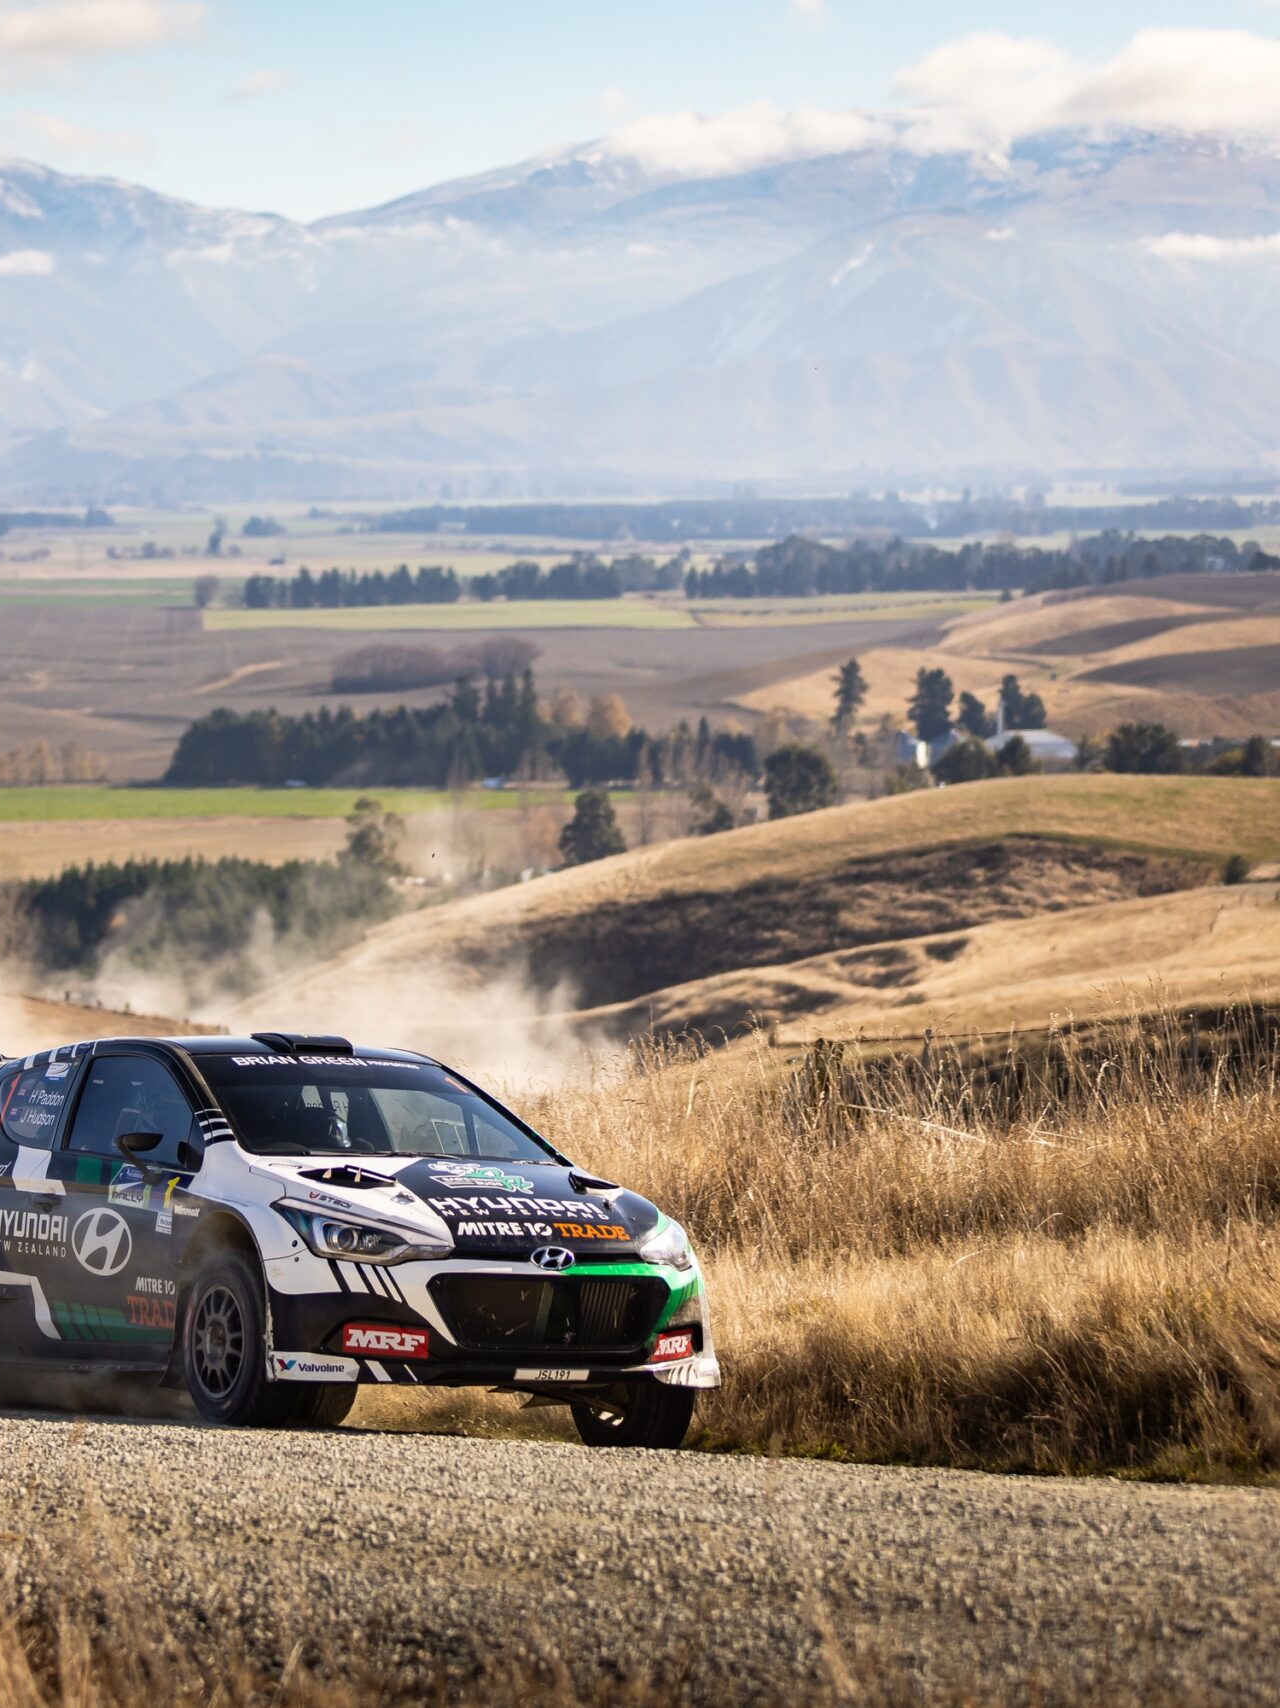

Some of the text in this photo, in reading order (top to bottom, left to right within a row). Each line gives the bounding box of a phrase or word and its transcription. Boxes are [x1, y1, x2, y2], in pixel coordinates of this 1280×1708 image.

[232, 1056, 297, 1066] BRIAN
[299, 1056, 367, 1067] GREEN
[28, 1089, 65, 1106] H Paddon
[20, 1108, 56, 1126] J Hudson
[112, 1191, 144, 1203] RALLY
[163, 1177, 181, 1209] 1
[319, 1195, 352, 1209] STEDI
[428, 1197, 603, 1214] HYUNDAI
[440, 1209, 610, 1220] NEW ZEALAND
[458, 1222, 630, 1241] MITRE 10 TRADE
[17, 1240, 67, 1258] ZEALAND
[135, 1276, 176, 1296] MITRE 10
[346, 1328, 426, 1351] MRF
[653, 1334, 693, 1356] MRF
[298, 1362, 345, 1374] Valvoline
[534, 1369, 570, 1381] JSL191
